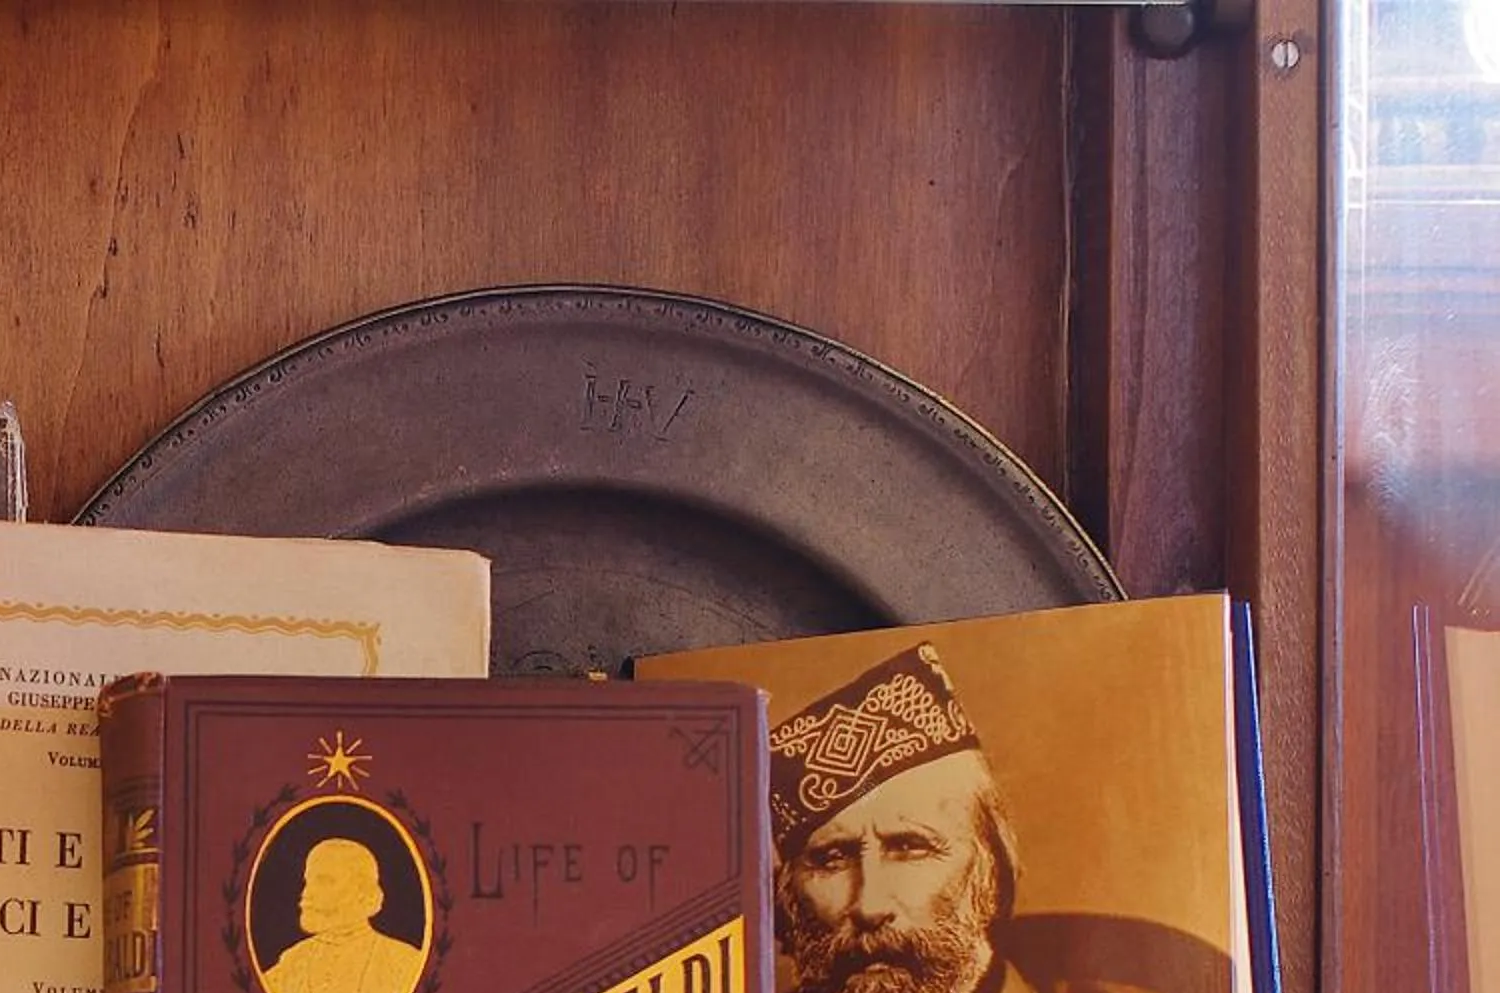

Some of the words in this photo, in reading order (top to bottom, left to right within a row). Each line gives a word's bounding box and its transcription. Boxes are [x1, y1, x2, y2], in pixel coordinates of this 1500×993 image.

[0, 666, 120, 688] NAZIONAL
[8, 691, 95, 711] GIUSEPPE
[0, 718, 57, 734] DELLA
[55, 831, 83, 869] E
[617, 843, 671, 912] OF
[64, 901, 91, 939] E
